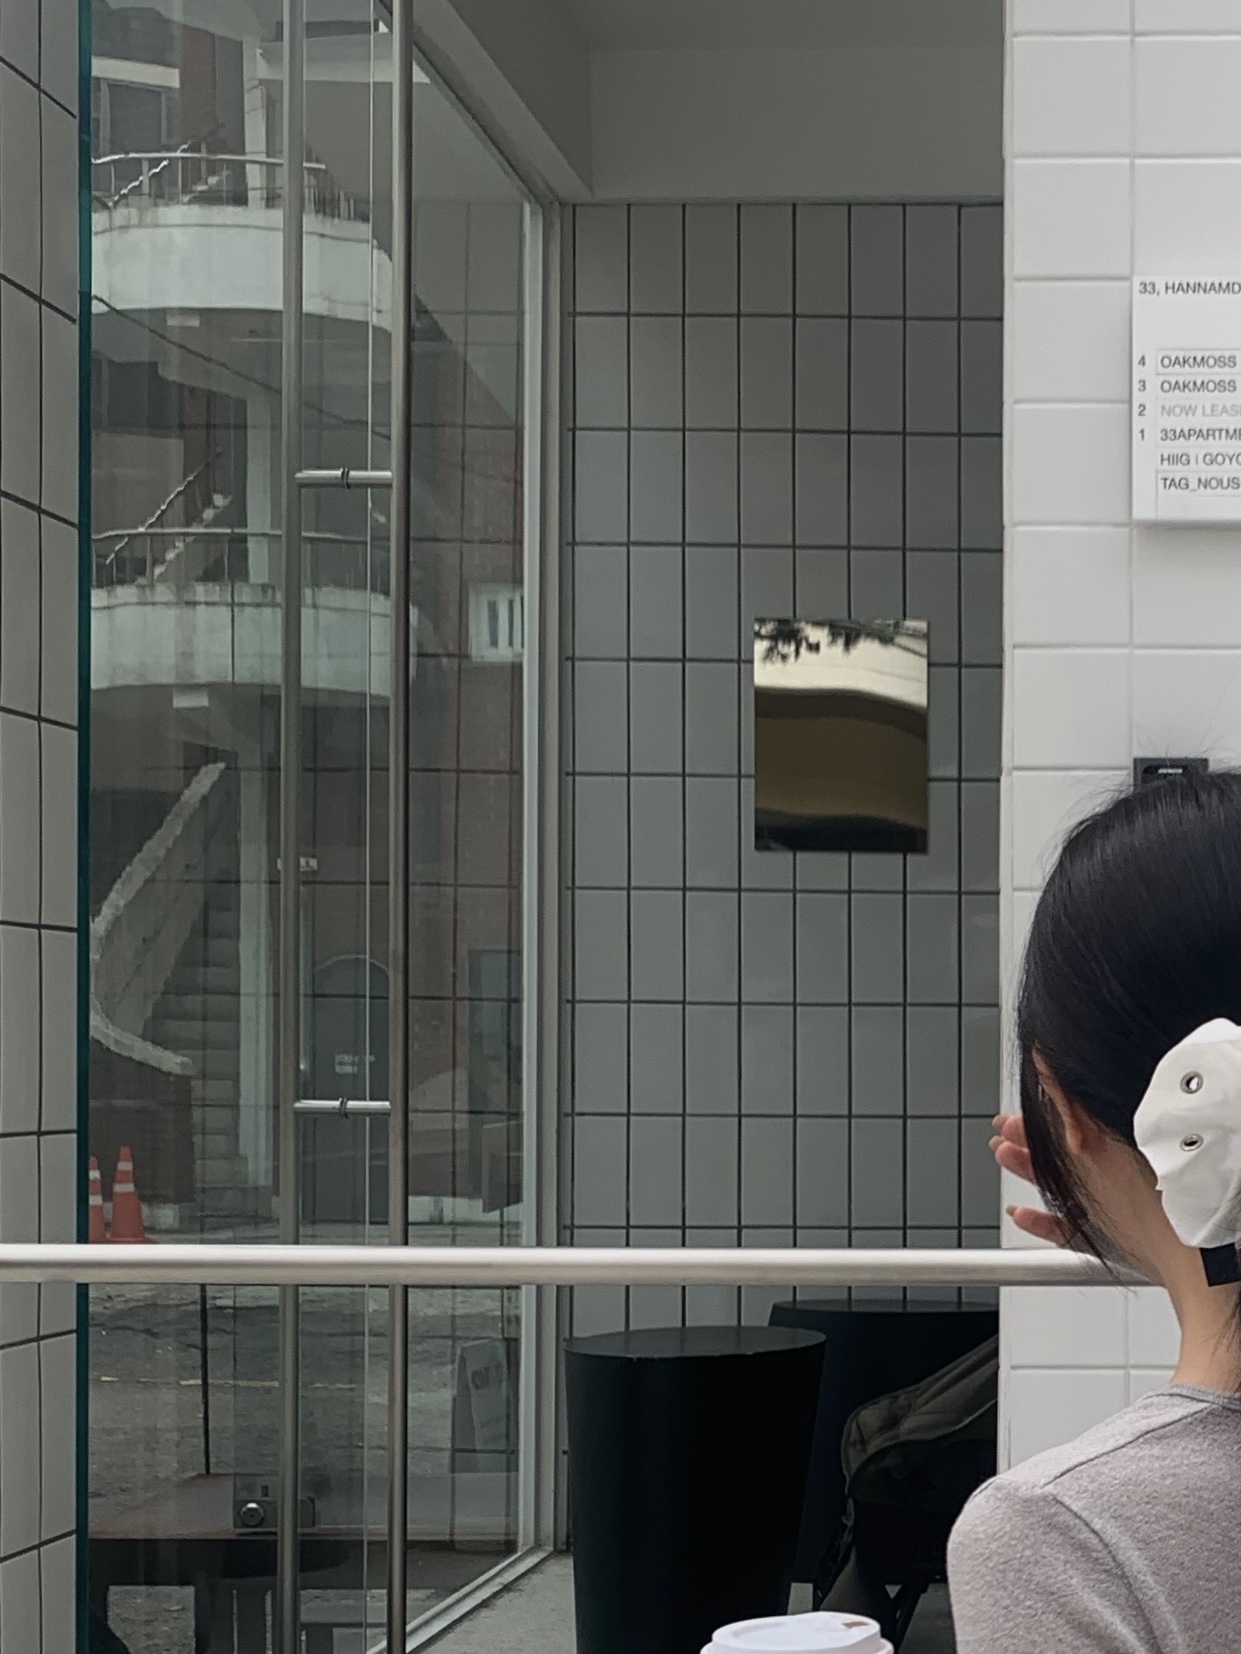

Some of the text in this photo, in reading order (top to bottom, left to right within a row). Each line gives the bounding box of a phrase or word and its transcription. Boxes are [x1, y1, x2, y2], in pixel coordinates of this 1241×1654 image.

[1139, 282, 1160, 296] 33,
[1138, 355, 1237, 369] 4 OAKMOSS
[1138, 379, 1237, 393] 3 OAKMOSS
[1138, 405, 1146, 417] 2
[1160, 404, 1197, 418] NOW
[1139, 429, 1145, 441] 1
[1160, 453, 1191, 466] HIIG
[1160, 477, 1241, 492] TAG_NOUS
